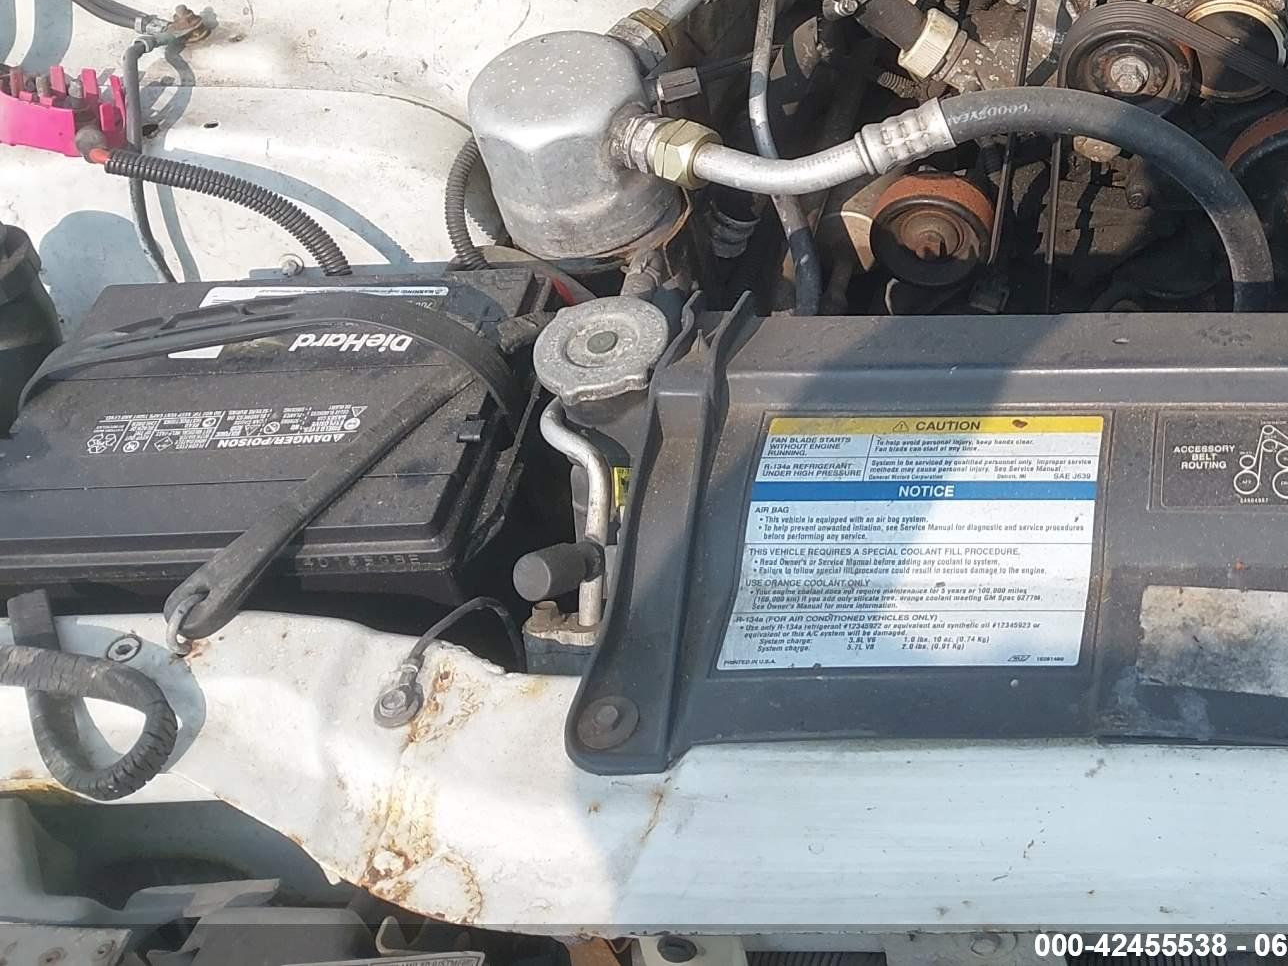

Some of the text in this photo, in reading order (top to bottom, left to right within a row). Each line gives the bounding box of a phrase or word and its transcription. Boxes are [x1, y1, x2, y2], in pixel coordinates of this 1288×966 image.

[288, 333, 413, 352] DieHard
[916, 421, 980, 431] CAUTION
[217, 434, 332, 448] DANGER/POISON
[1173, 445, 1235, 453] ACCESSORY
[1181, 461, 1227, 469] ROUTING
[899, 486, 955, 497] NOTICE
[816, 516, 847, 524] equipped
[888, 516, 900, 524] bag
[902, 516, 928, 524] system.
[912, 614, 938, 622] ONLY)
